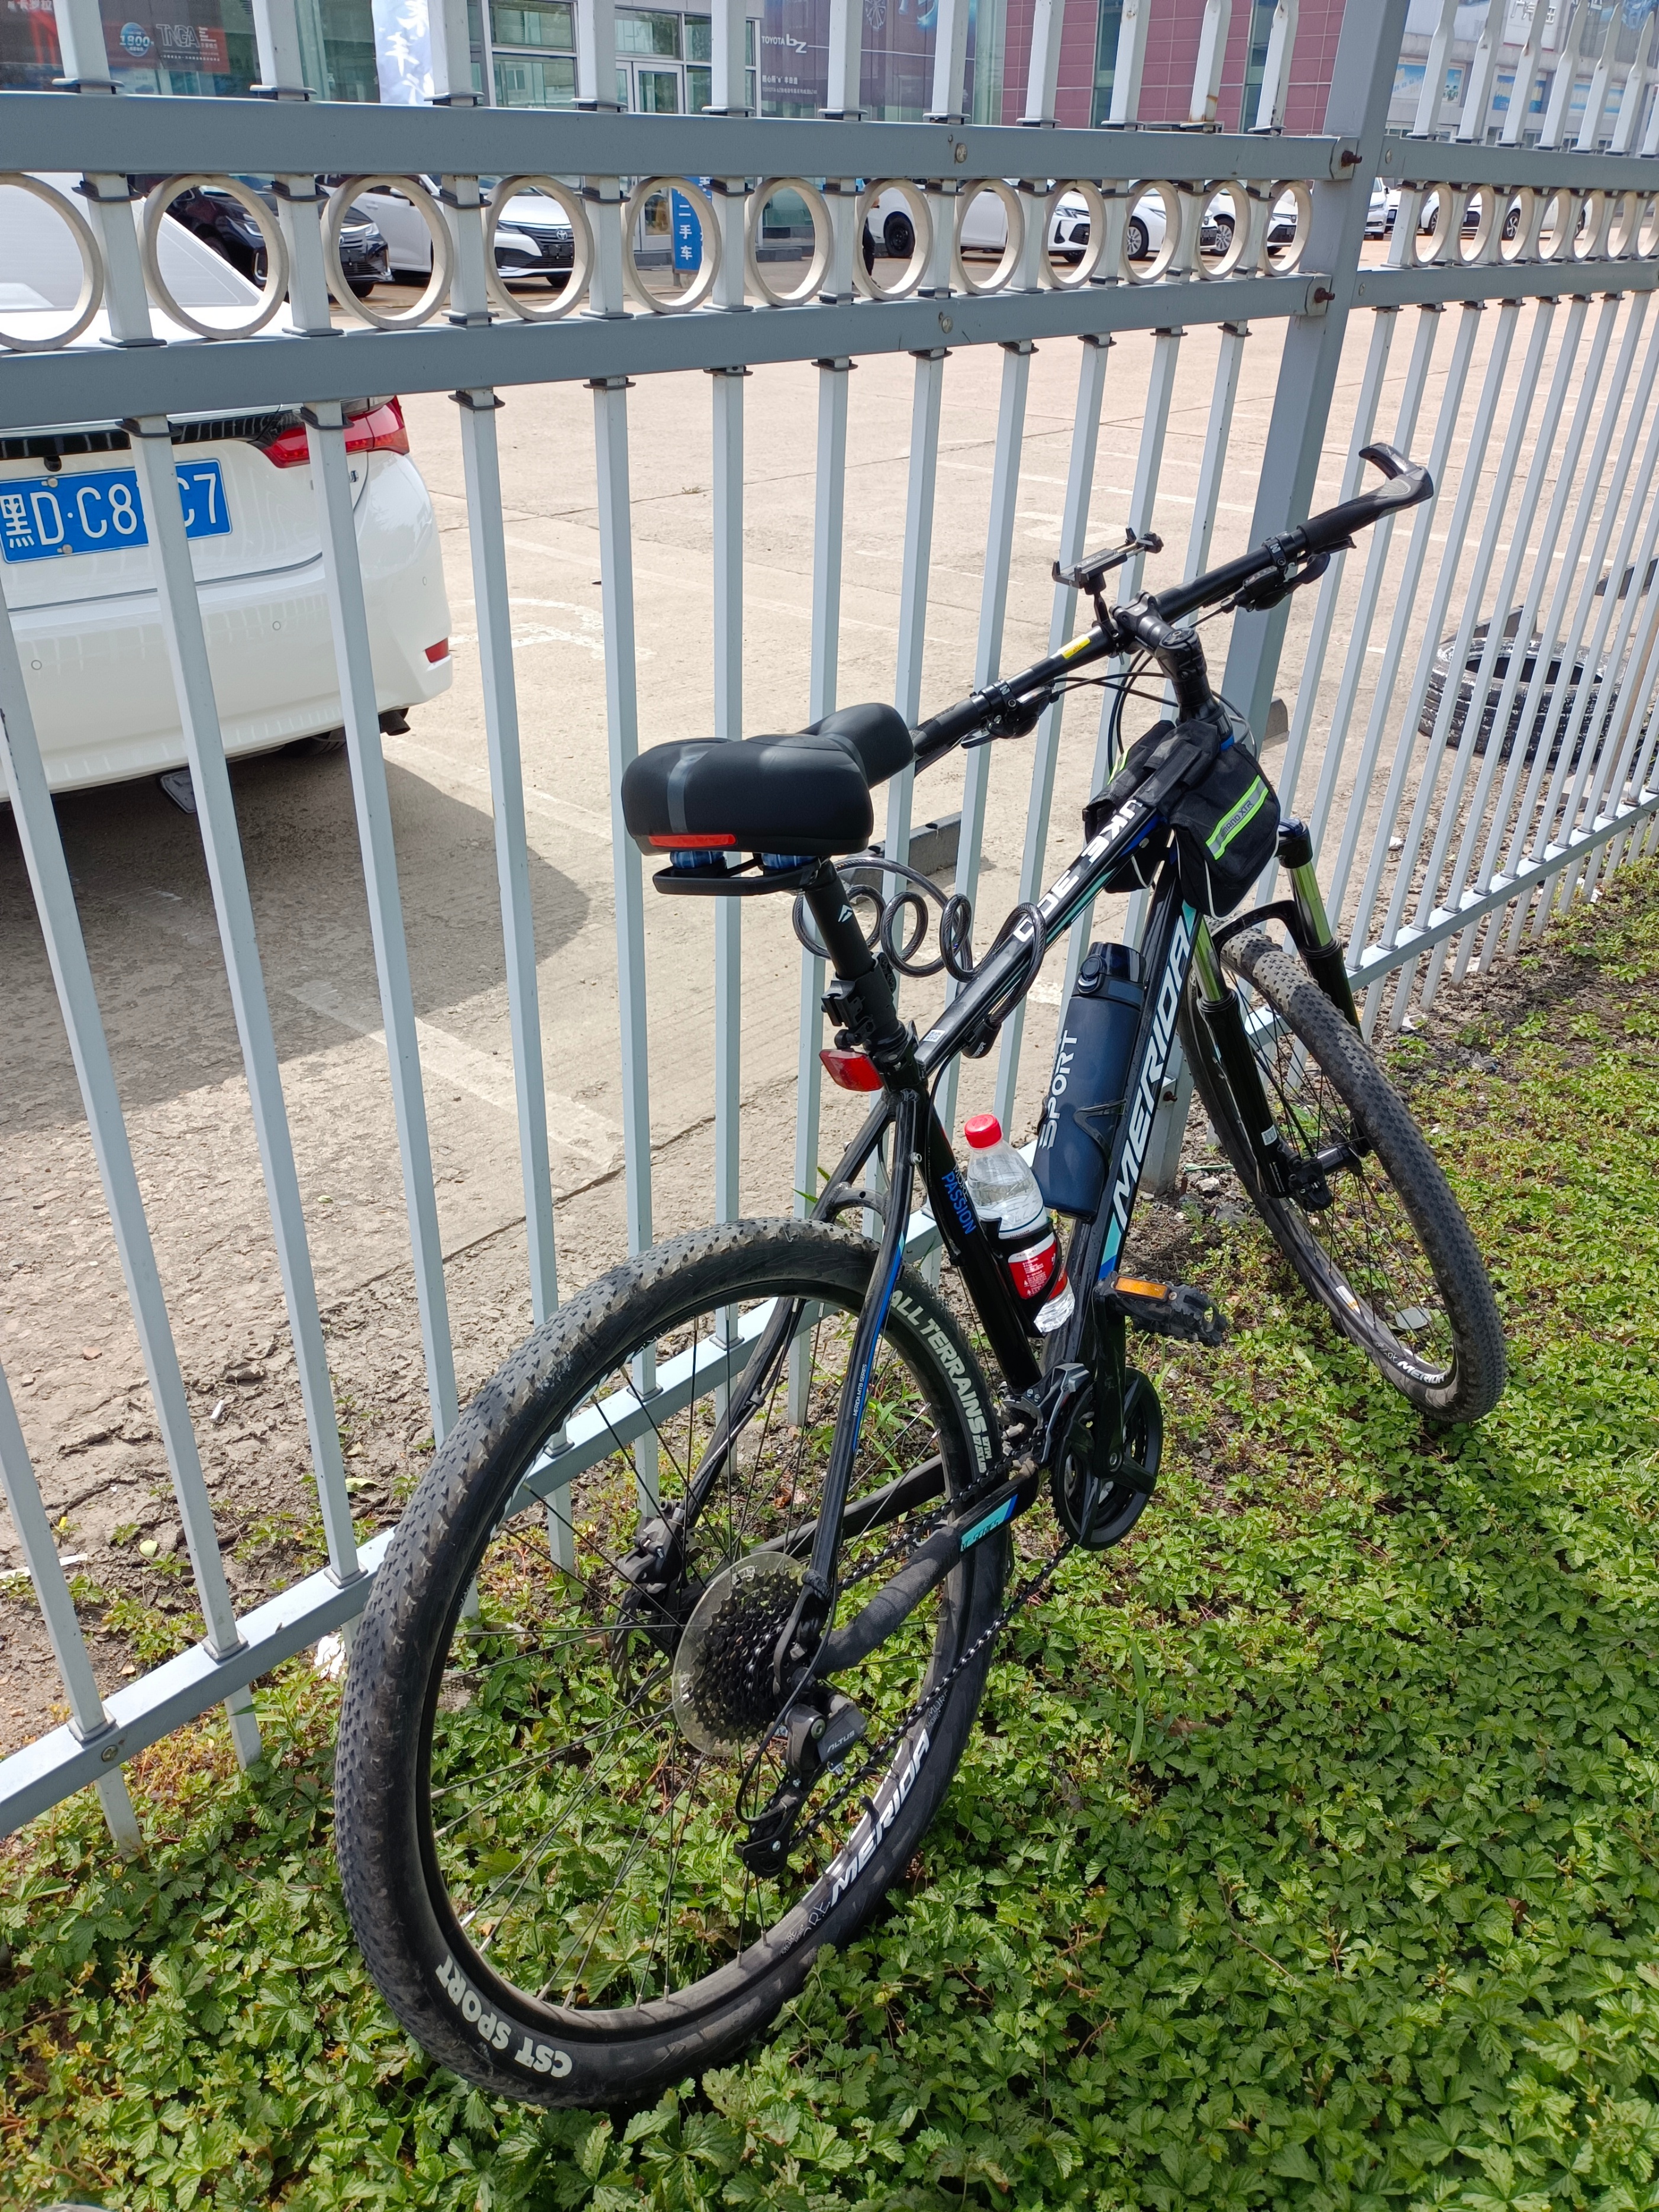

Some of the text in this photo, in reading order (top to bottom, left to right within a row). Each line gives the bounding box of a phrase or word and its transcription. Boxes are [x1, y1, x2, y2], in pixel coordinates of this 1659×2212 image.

[156, 24, 200, 48] TNGA
[761, 36, 785, 45] TOYOTA
[1510, 0, 1557, 24] 广汽田
[678, 191, 692, 260] 二手车
[1, 473, 217, 549] 黑D·C8C7
[1080, 799, 1143, 864] UKE
[1221, 800, 1253, 839] SMANO XTR
[1038, 1030, 1077, 1150] SPORT
[1113, 915, 1190, 1231] MERIDA
[941, 1171, 977, 1234] PASSION
[889, 1289, 987, 1434] ALL TERRAINS
[1397, 1360, 1445, 1384] MERIDA
[853, 1395, 861, 1417] MERIDA
[827, 1730, 855, 1753] ALTUS
[830, 1729, 929, 1906] MERIDA
[435, 1955, 573, 2078] CST SPORT
